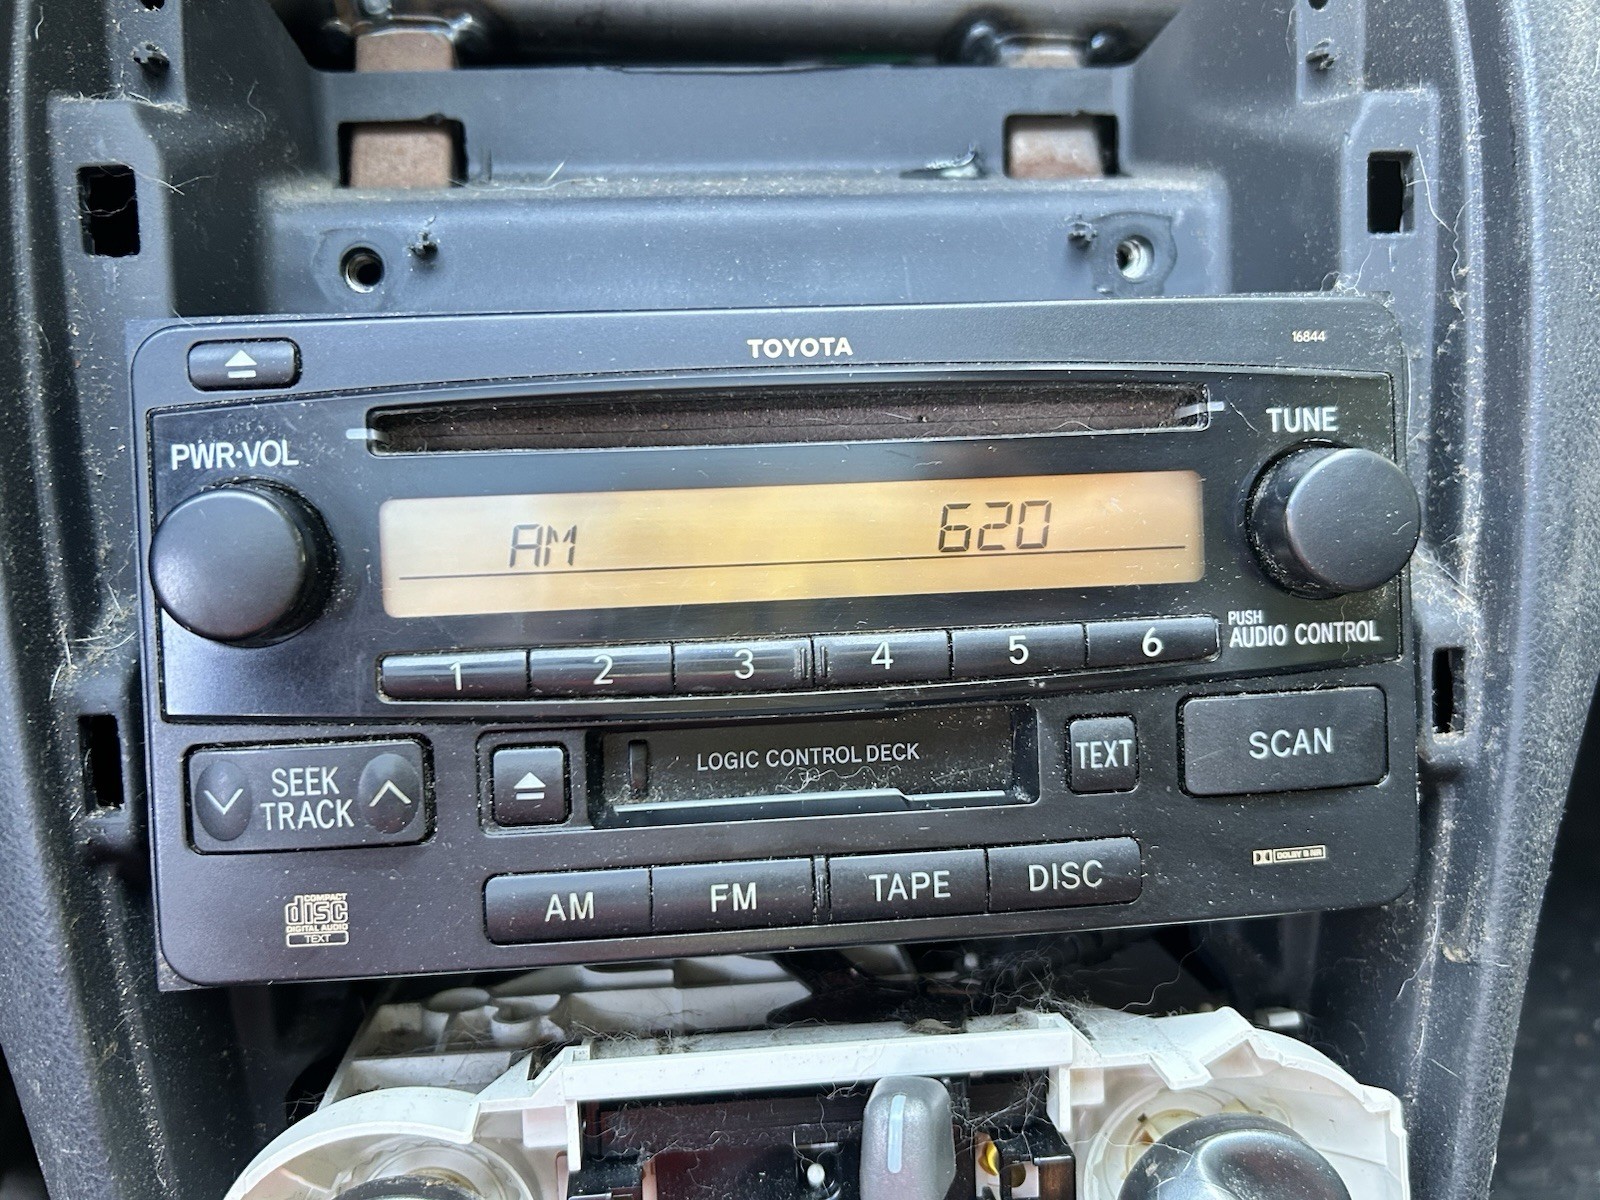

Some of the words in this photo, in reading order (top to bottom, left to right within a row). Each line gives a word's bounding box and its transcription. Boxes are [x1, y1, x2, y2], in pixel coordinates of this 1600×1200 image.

[747, 337, 853, 359] TOYOTA
[1291, 330, 1326, 343] 16844
[1265, 406, 1340, 433] TUNE
[938, 499, 1052, 553] 620
[508, 523, 577, 568] AM
[1227, 609, 1264, 625] PUSH
[1141, 628, 1163, 657] 6
[1229, 624, 1288, 647] AUDIO
[1294, 619, 1381, 645] CONTROL
[733, 648, 755, 680] 3
[870, 641, 893, 671] 4
[1008, 634, 1030, 665] 5
[448, 661, 463, 691] 1
[592, 654, 615, 685] 2
[696, 750, 760, 773] LOGIC
[764, 745, 865, 769] CONTROL
[866, 742, 921, 763] DECK
[1075, 738, 1133, 769] TEXT
[1248, 727, 1333, 760] SCAN
[271, 766, 340, 797] SEEK
[259, 798, 354, 832] TRACK
[868, 871, 951, 902] TAPE
[1028, 859, 1103, 892] DISC
[285, 895, 348, 925] disc
[304, 893, 348, 902] COMPACT
[544, 891, 596, 923] AM
[710, 882, 758, 913] FM
[286, 925, 320, 933] DIGITAL
[321, 923, 349, 932] AUDIO
[304, 934, 332, 943] TEXT
